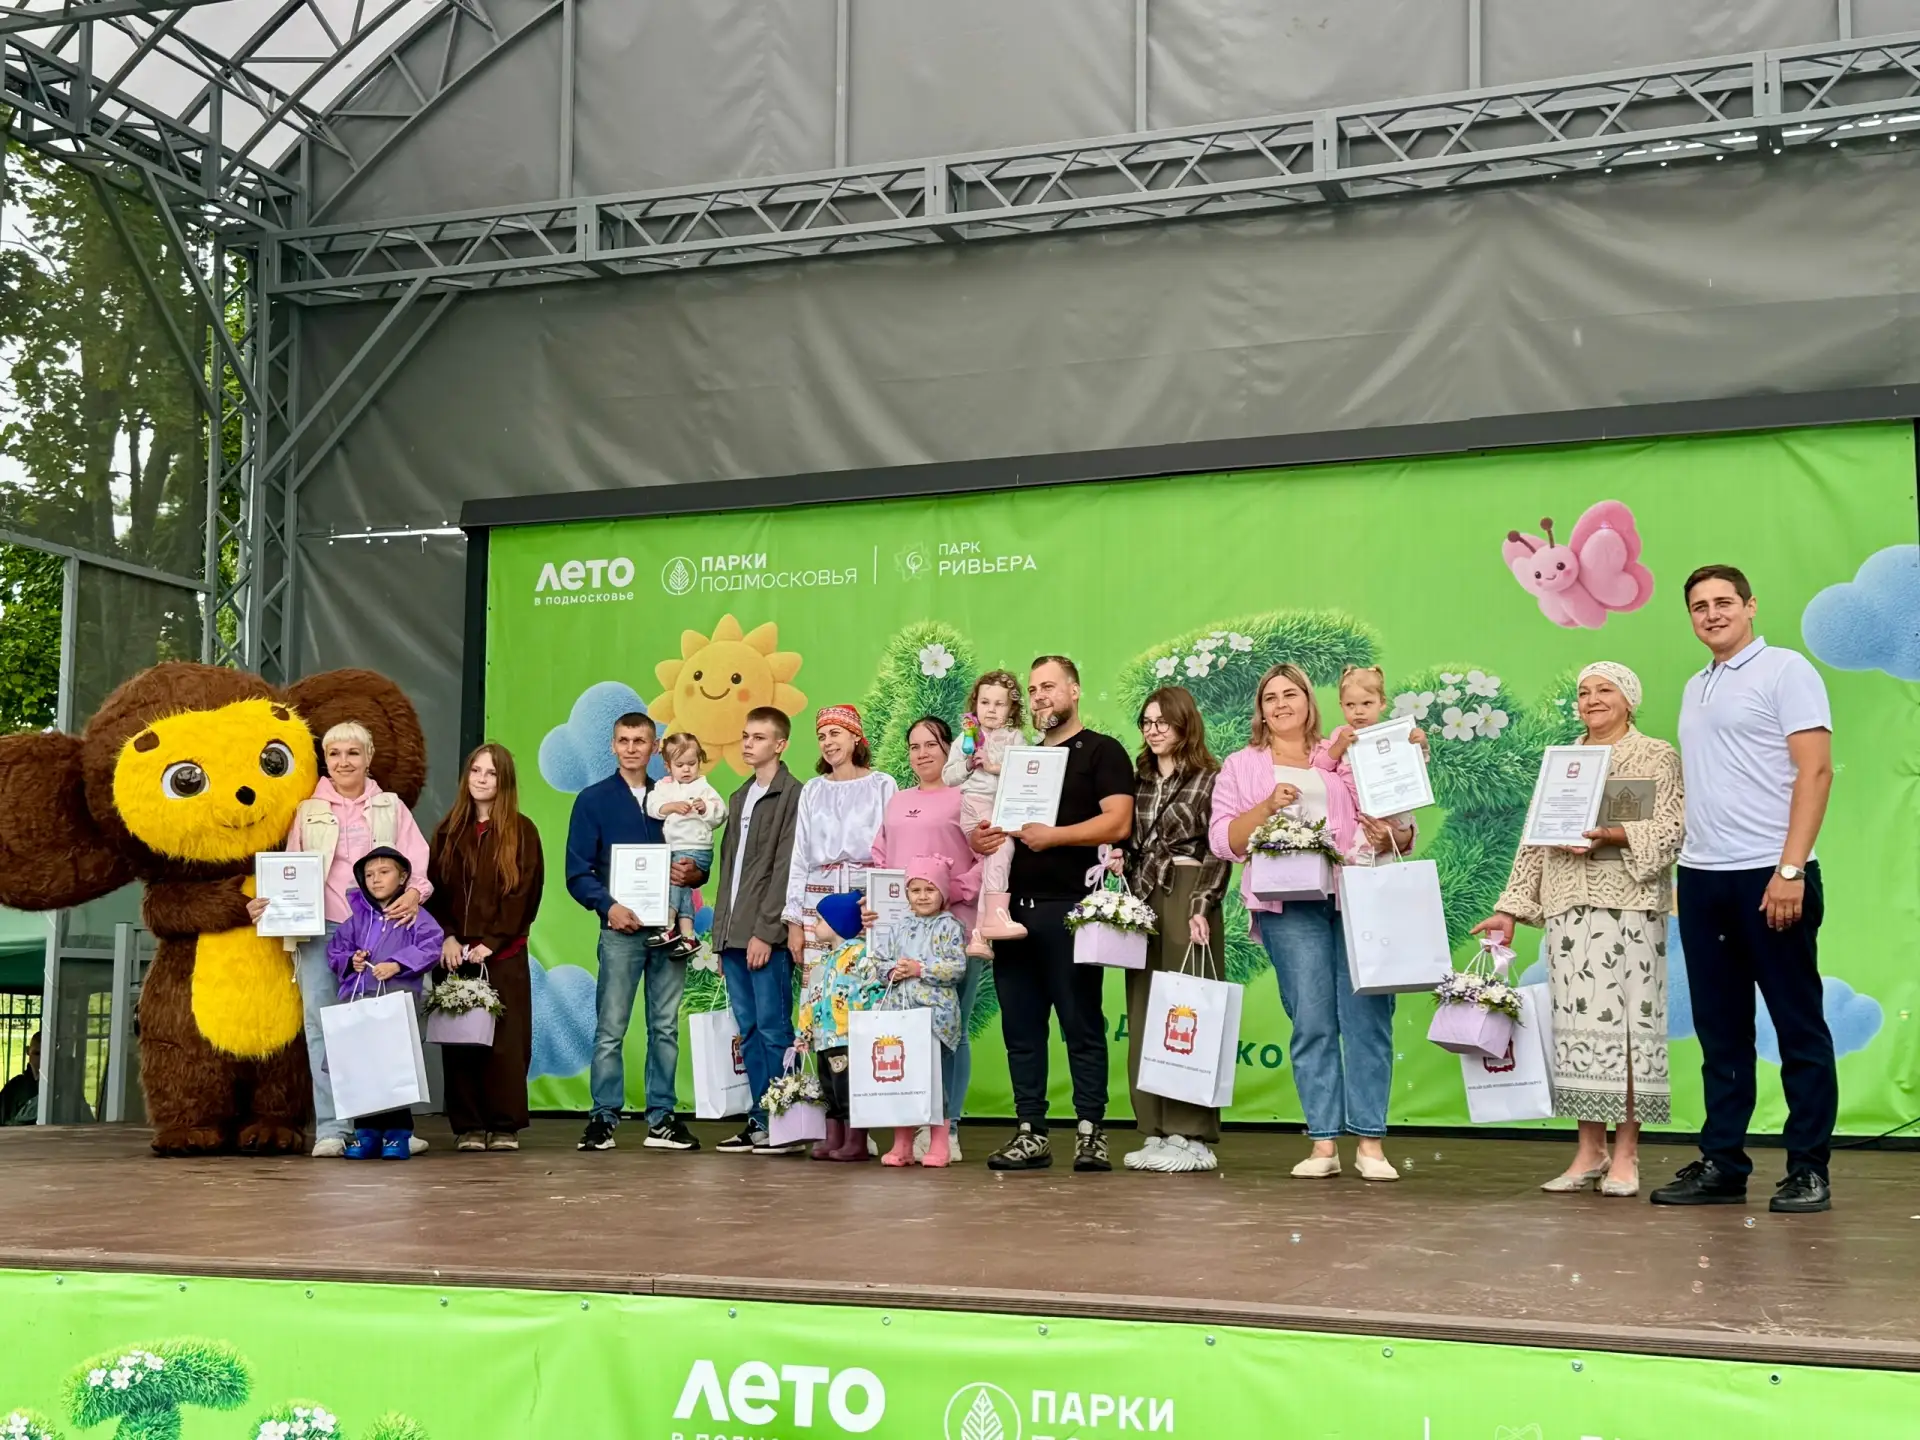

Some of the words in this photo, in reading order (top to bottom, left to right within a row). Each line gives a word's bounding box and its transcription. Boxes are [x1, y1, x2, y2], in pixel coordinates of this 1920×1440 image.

[938, 541, 981, 556] ПАРК
[701, 552, 767, 573] ПАРКИ
[938, 554, 1037, 577] РИВЬЕРА
[701, 567, 857, 593] ПОДМОСКОВЬЯ
[1031, 1389, 1175, 1433] ПАРКИ
